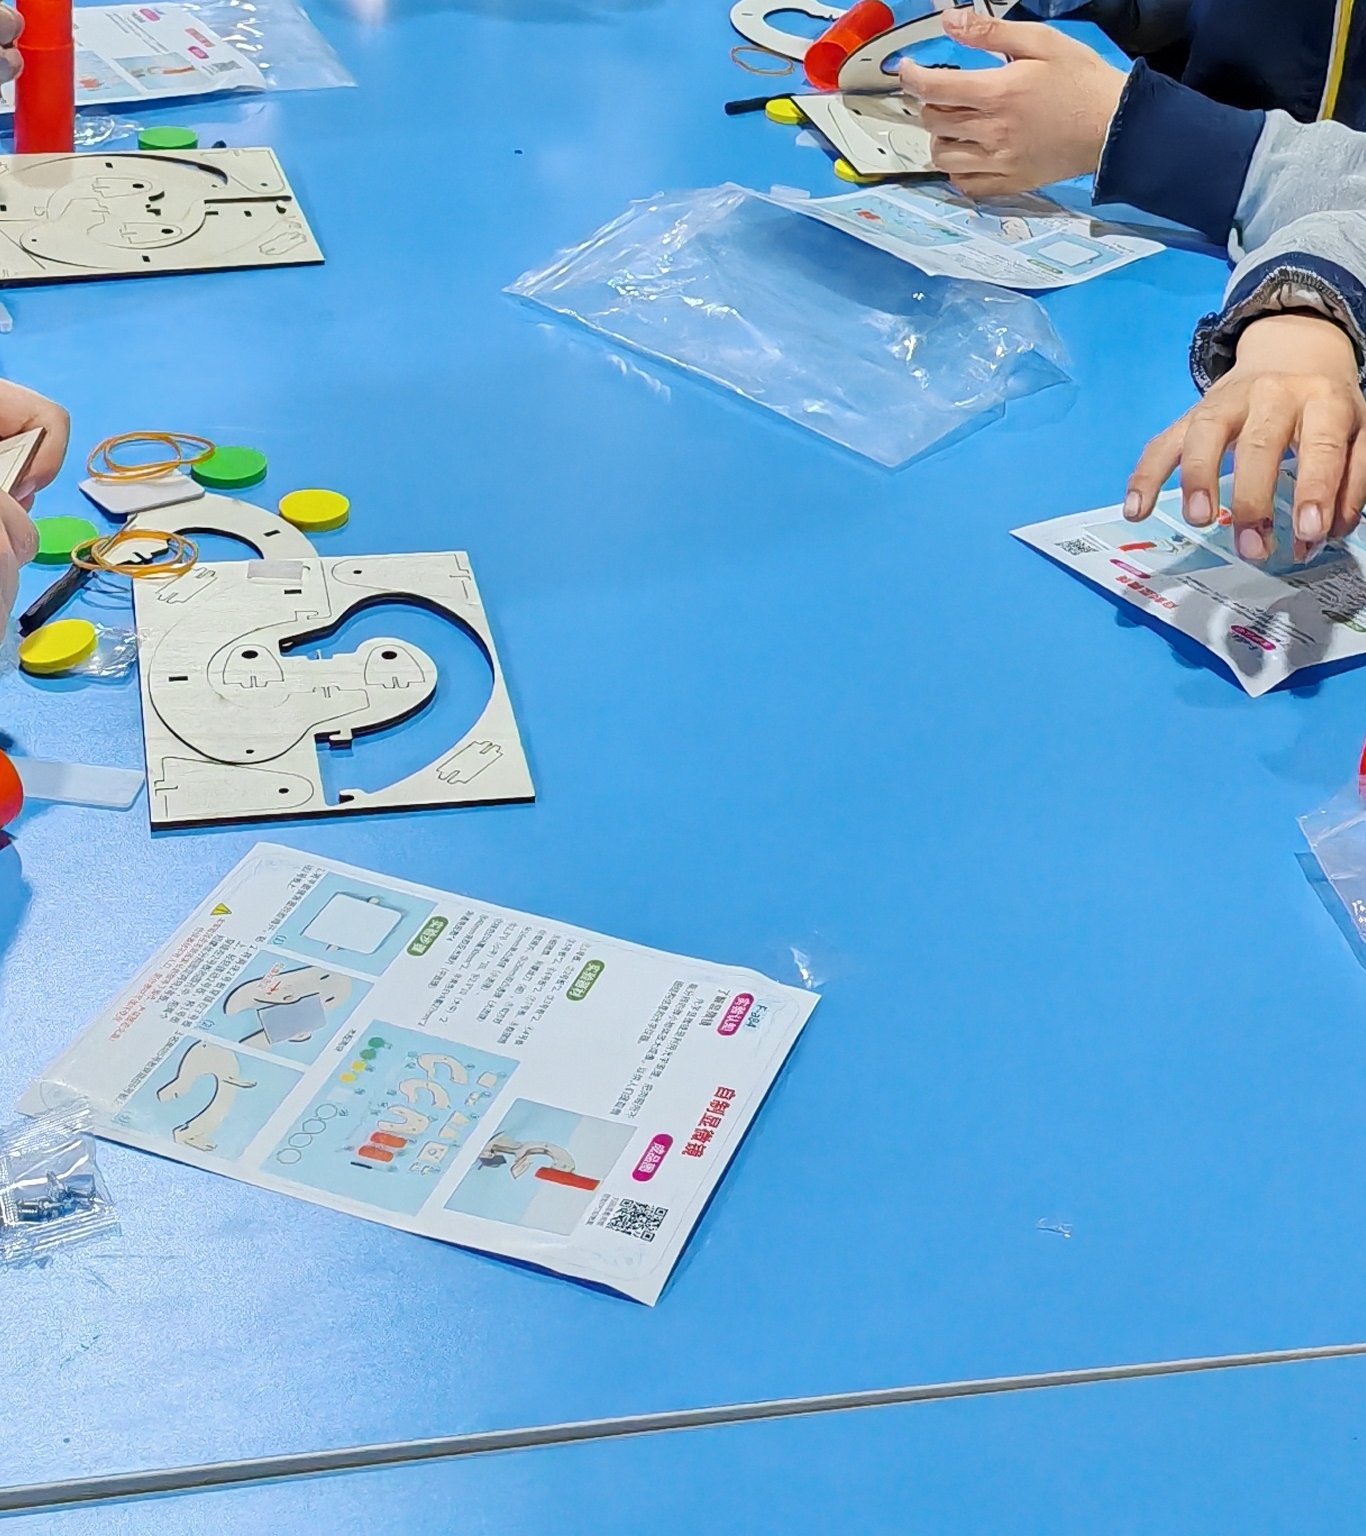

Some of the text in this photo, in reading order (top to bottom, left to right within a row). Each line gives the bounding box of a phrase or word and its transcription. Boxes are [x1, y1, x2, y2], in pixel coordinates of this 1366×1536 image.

[718, 995, 752, 1033] 实验认知
[679, 1084, 738, 1160] 自制显微镜
